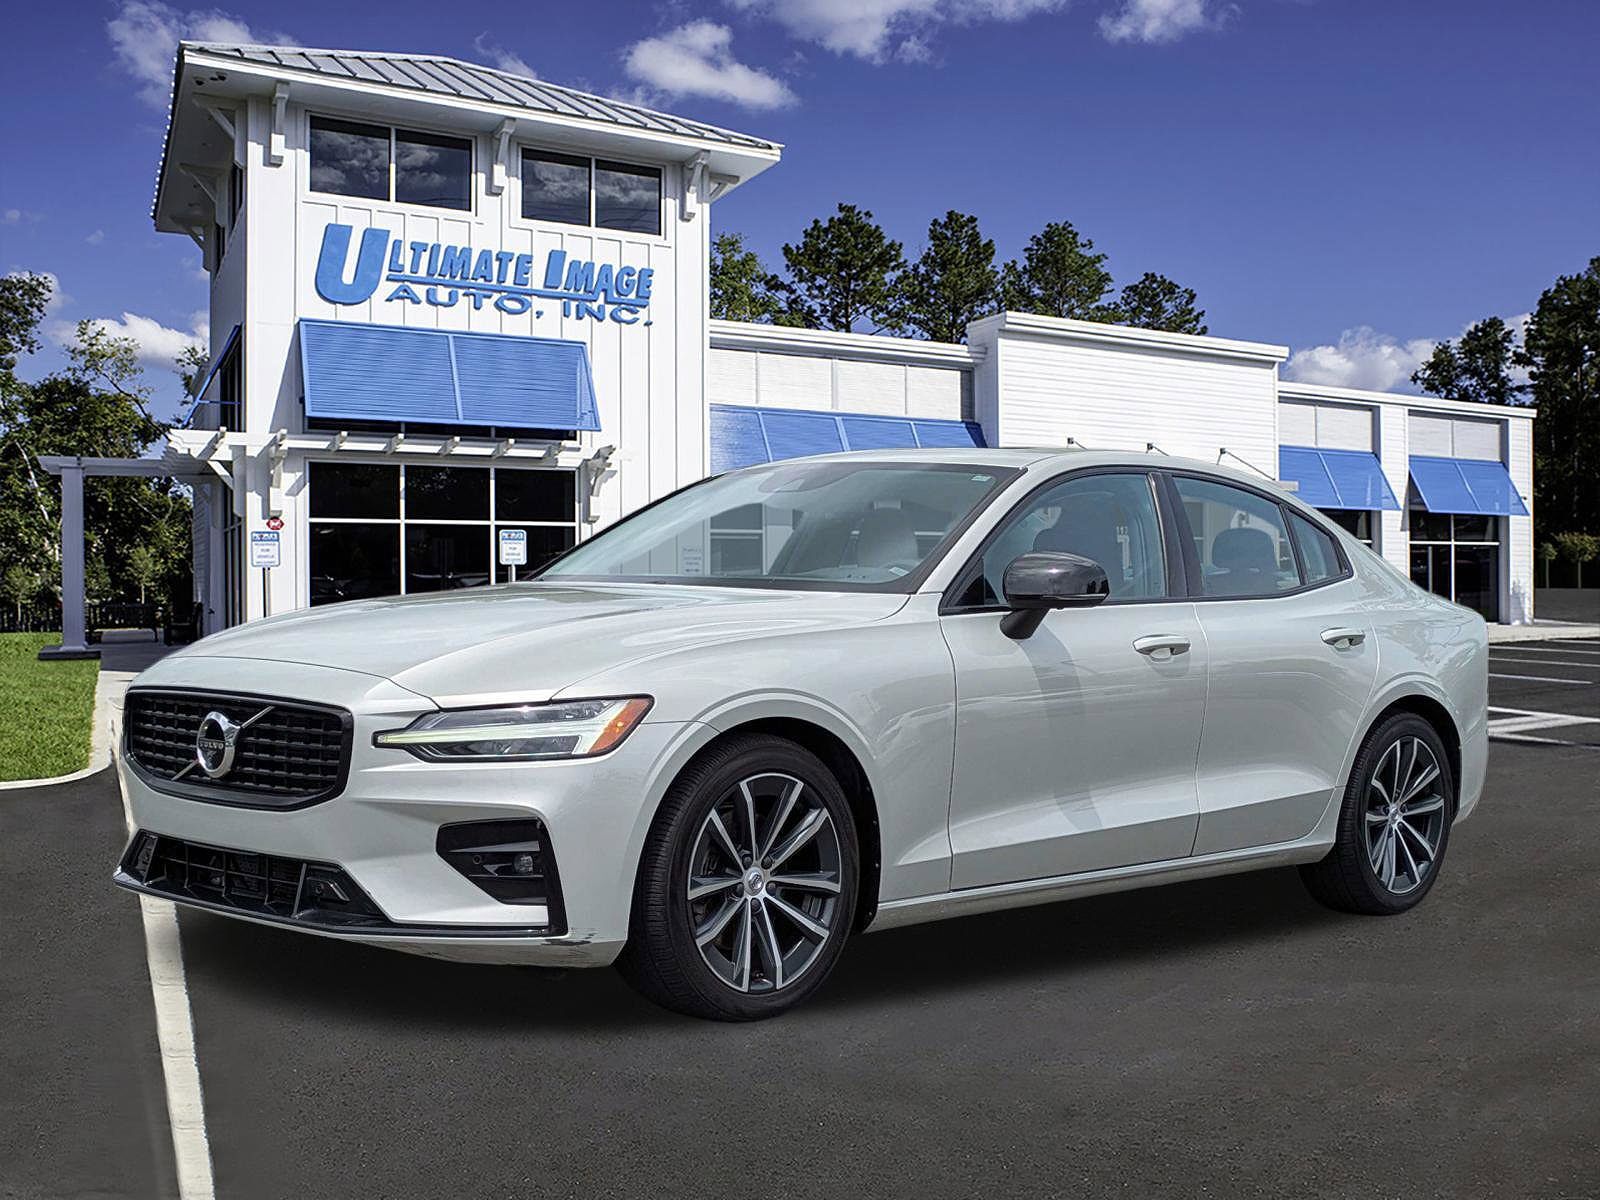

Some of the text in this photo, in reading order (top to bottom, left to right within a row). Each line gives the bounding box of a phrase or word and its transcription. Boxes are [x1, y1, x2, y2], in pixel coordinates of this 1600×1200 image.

[315, 223, 655, 305] ULTIMATE IMAGE
[385, 284, 654, 327] AUTO, INC.
[199, 741, 224, 750] VOLVO
